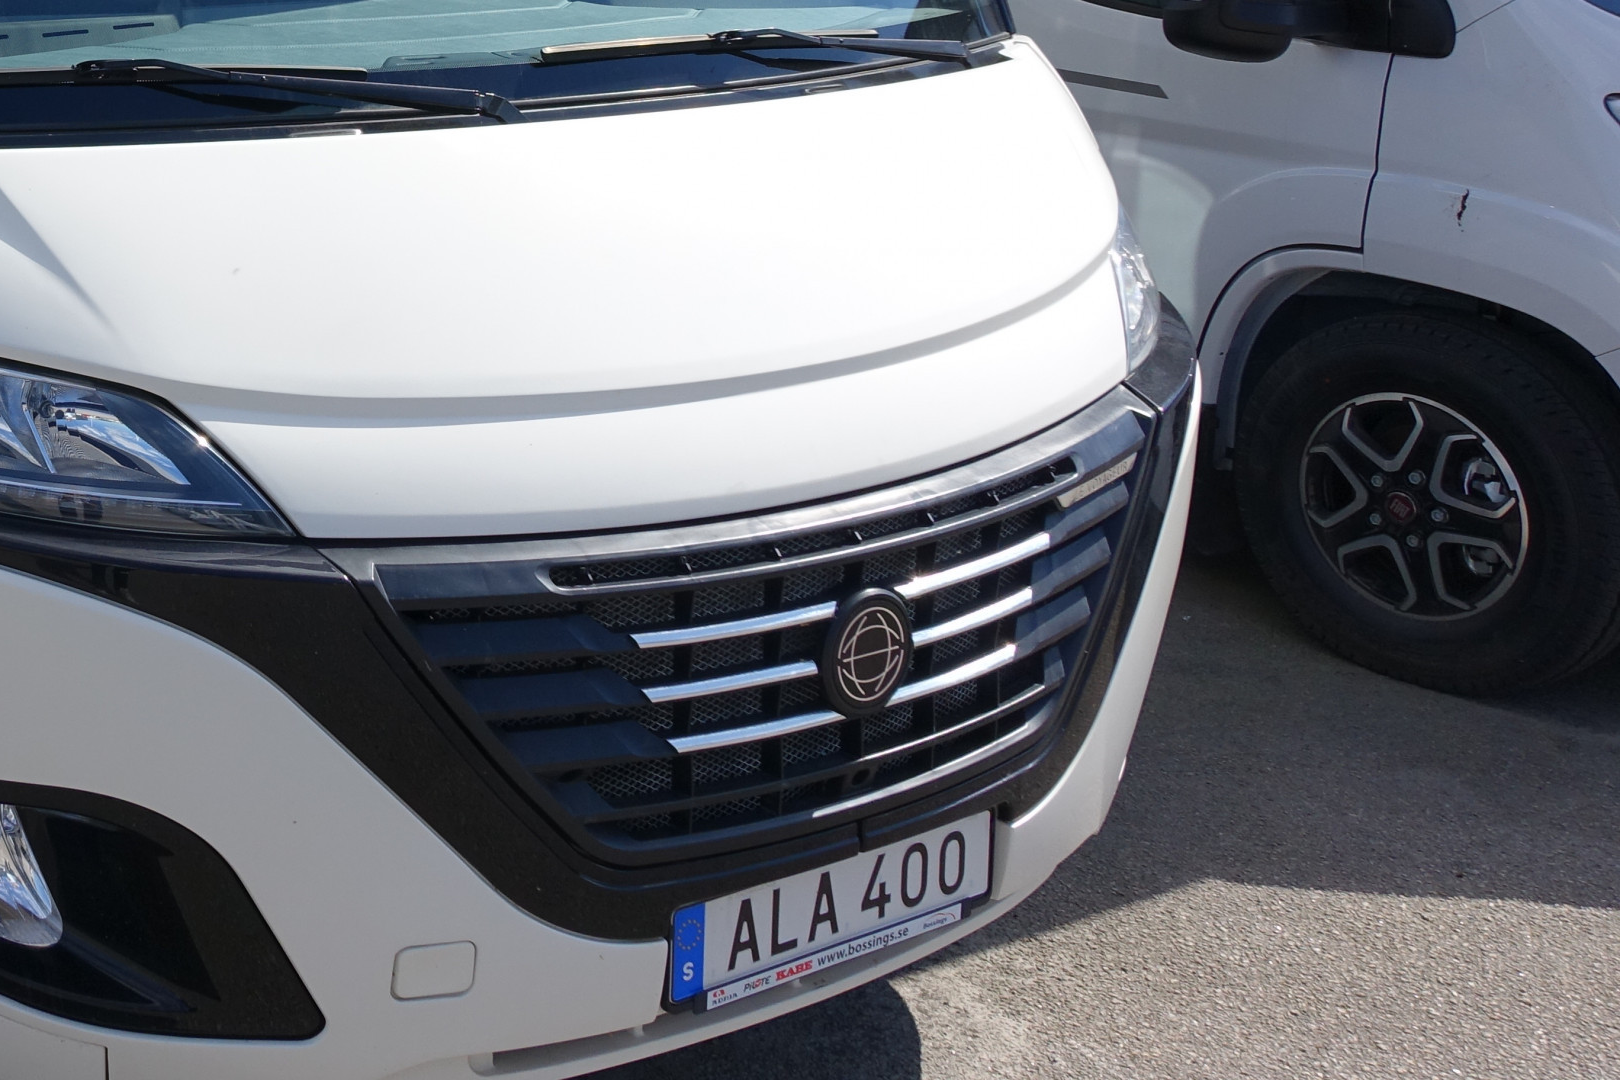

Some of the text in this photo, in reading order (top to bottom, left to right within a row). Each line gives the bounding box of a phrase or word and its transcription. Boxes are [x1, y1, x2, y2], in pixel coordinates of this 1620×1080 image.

[727, 830, 966, 971] ALA 400
[817, 926, 909, 967] www.bossings.se
[682, 962, 694, 981] S
